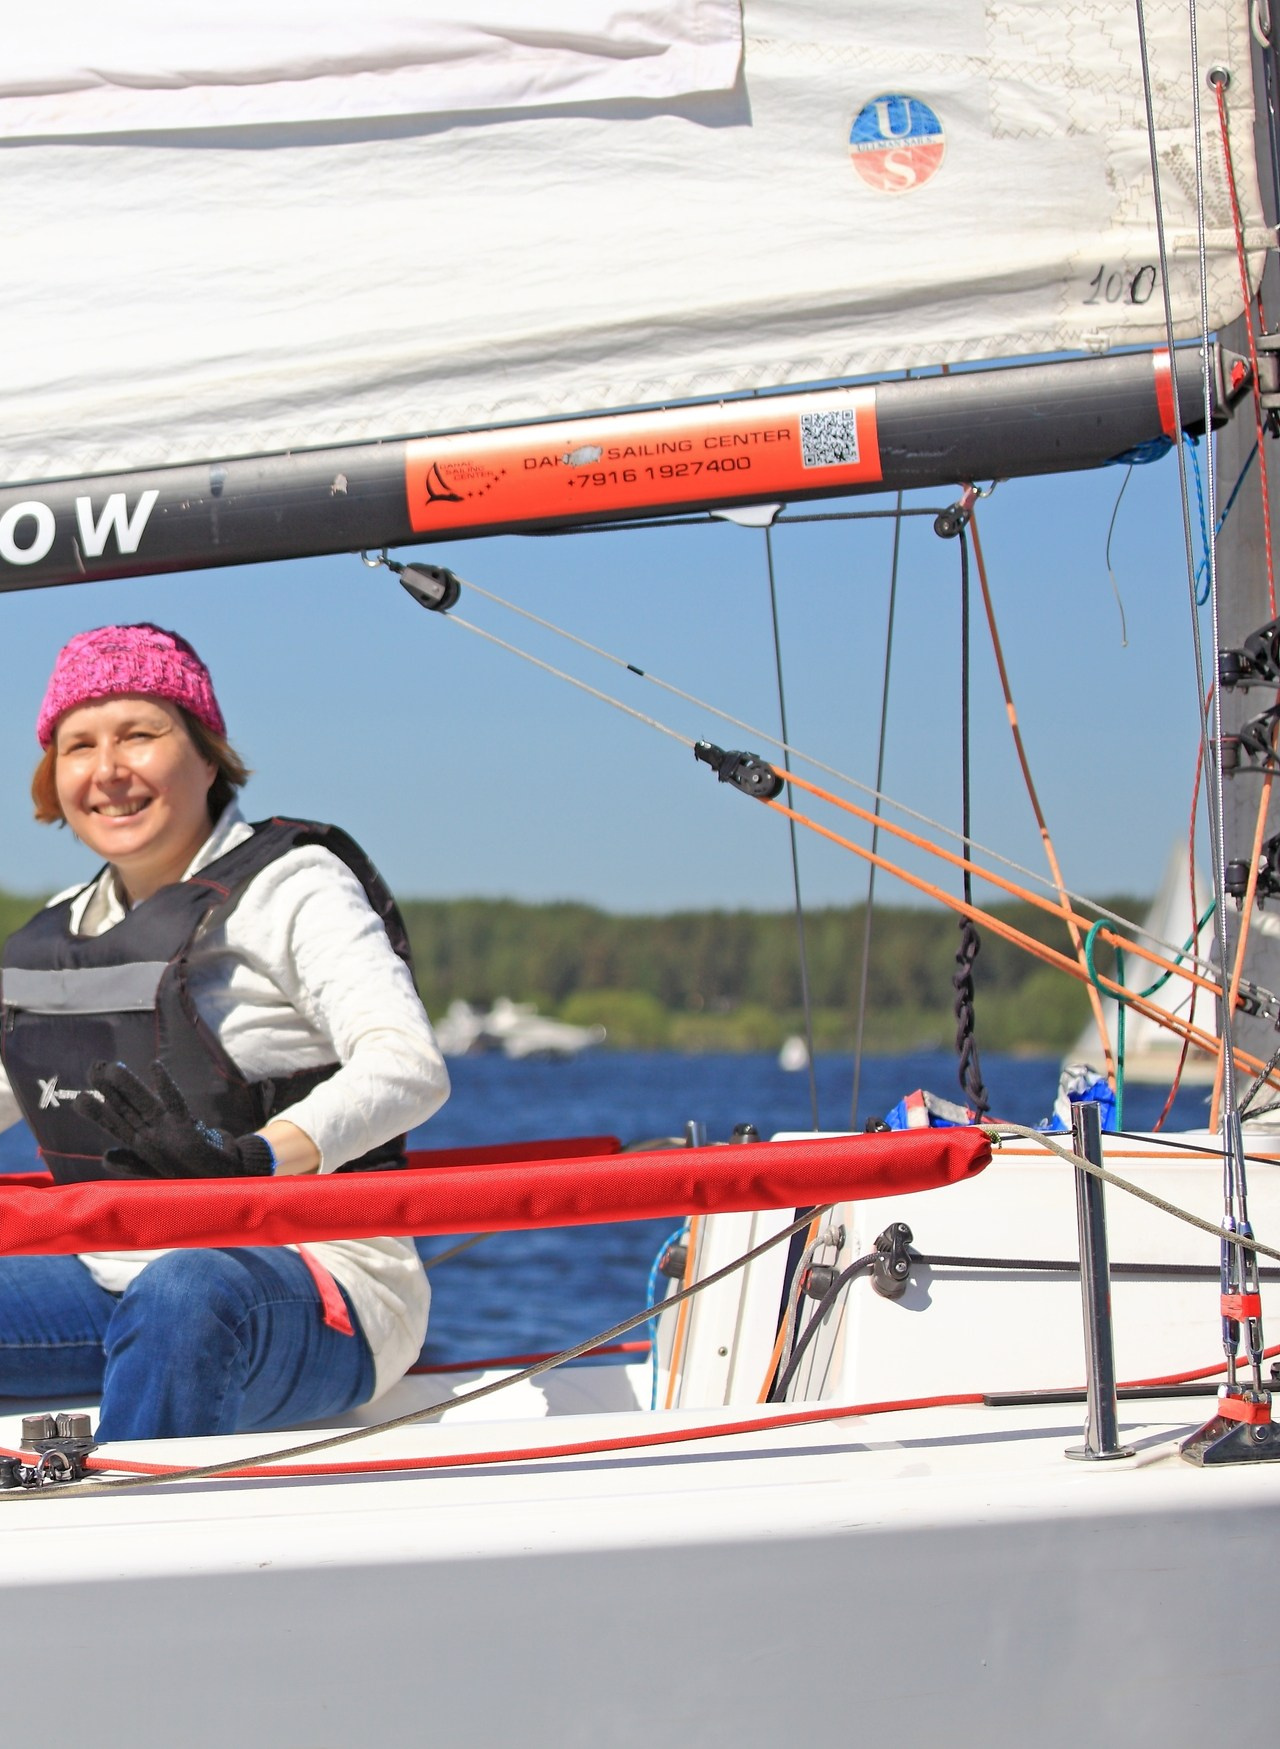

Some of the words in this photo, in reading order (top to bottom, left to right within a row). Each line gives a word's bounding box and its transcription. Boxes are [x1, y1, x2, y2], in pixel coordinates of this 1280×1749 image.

[608, 440, 693, 460] SAILING
[704, 429, 791, 449] CENTER
[568, 469, 637, 489] +7916
[646, 456, 752, 480] 1927400
